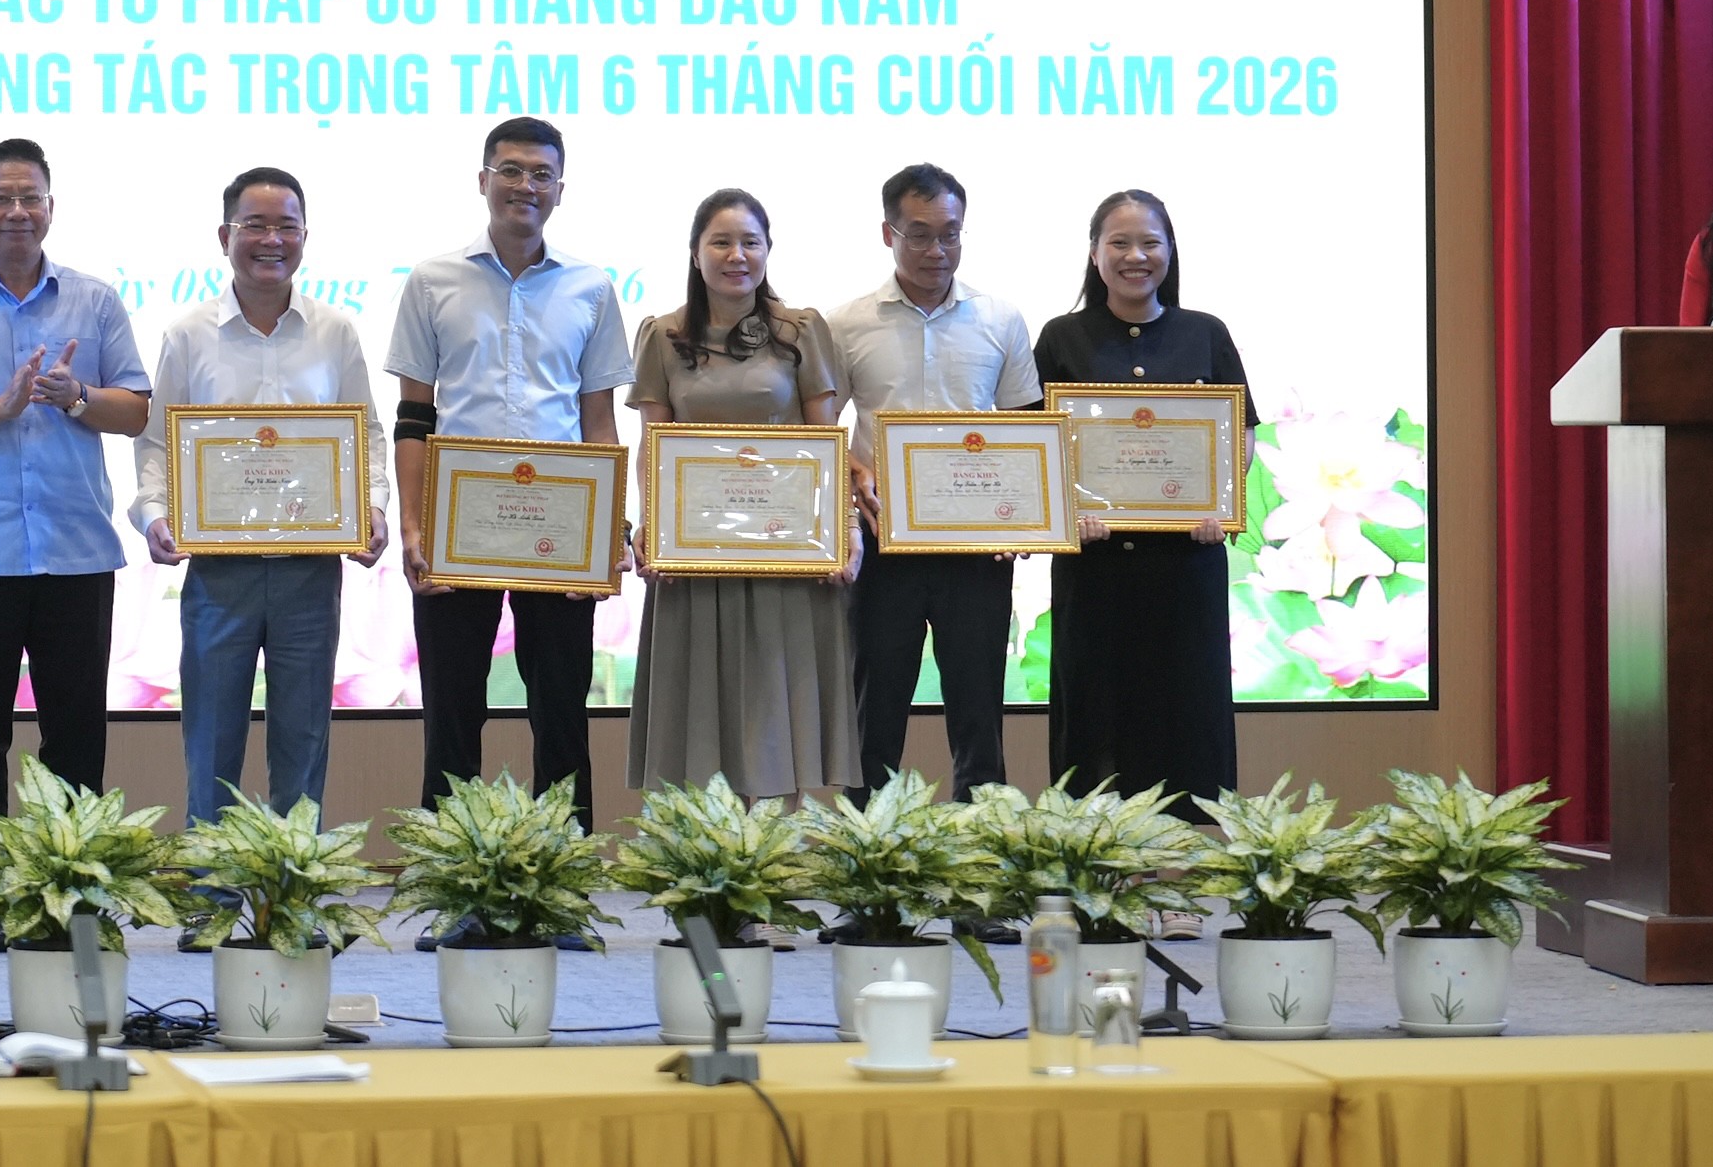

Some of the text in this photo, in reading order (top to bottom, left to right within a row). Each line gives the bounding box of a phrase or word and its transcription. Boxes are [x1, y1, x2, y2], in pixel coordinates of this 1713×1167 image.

[94, 40, 207, 115] TÁC
[229, 53, 429, 128] TRỌNG
[451, 40, 579, 115] TÂM
[602, 54, 636, 116] 6
[657, 41, 855, 116] THÁNG
[878, 33, 1015, 116] CUỐI
[1038, 42, 1175, 116] NĂM
[1197, 56, 1338, 117] 2026
